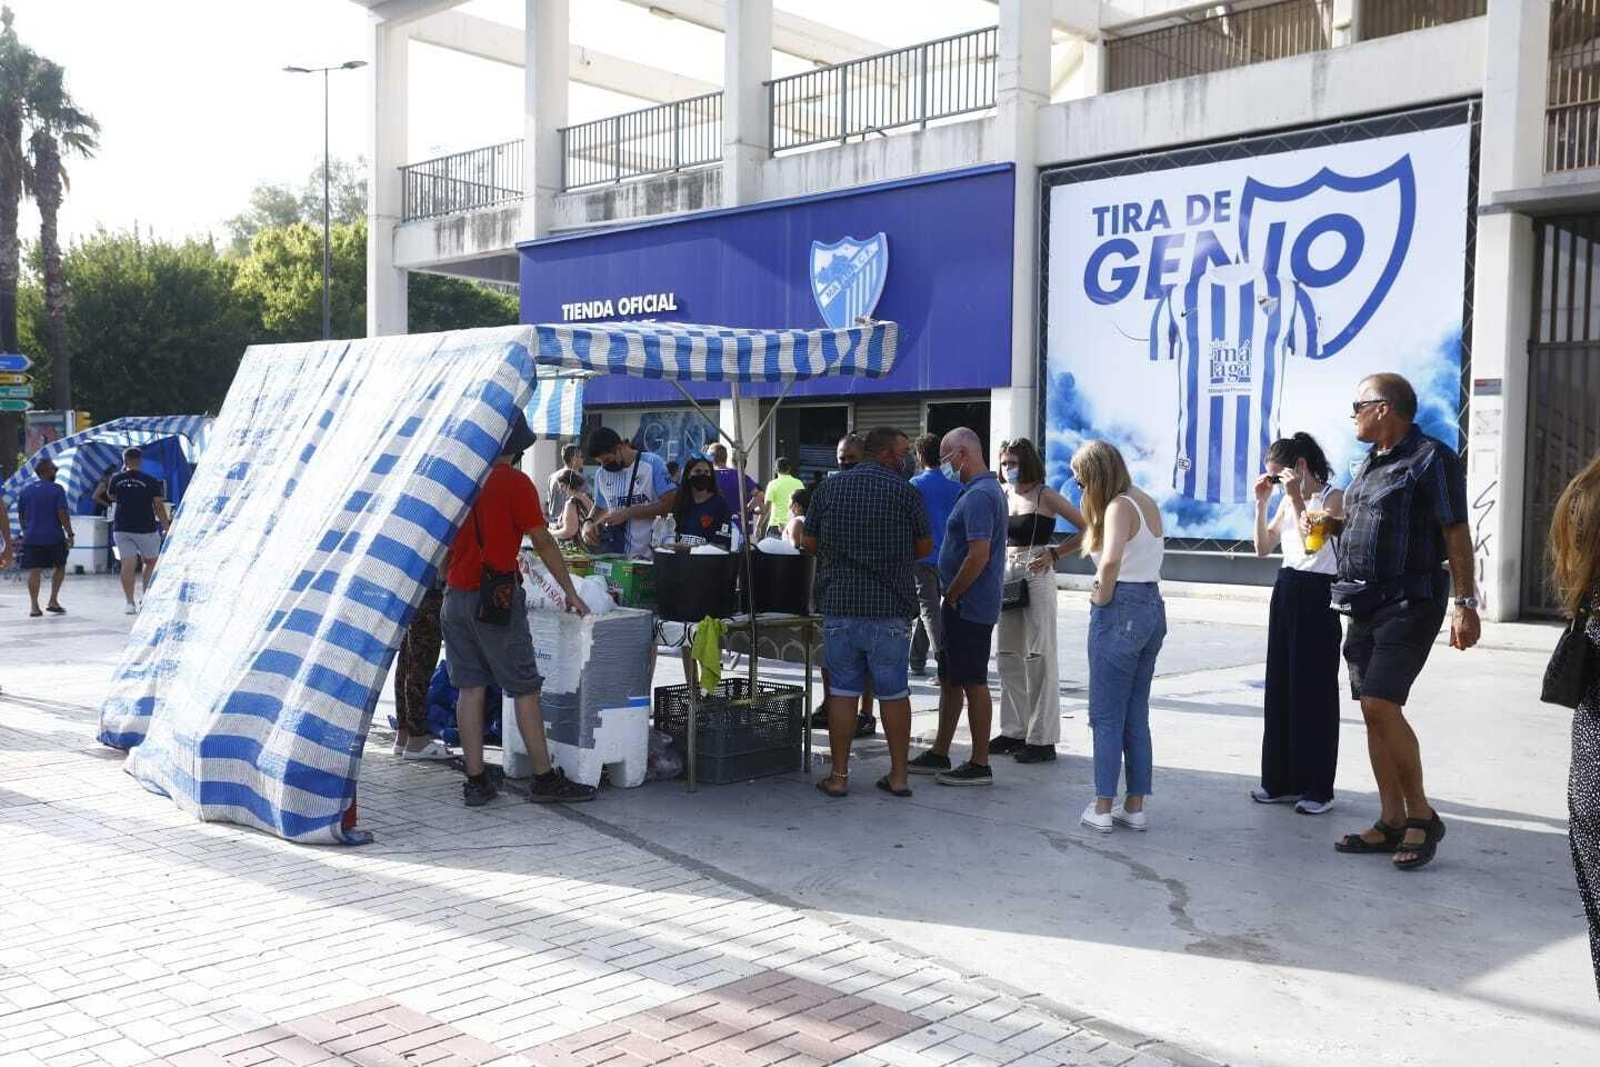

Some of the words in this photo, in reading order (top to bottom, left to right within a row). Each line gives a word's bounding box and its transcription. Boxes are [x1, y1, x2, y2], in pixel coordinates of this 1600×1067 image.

[1092, 199, 1171, 237] TIRA
[1186, 190, 1232, 227] DE
[561, 300, 614, 321] TIENDA
[618, 293, 677, 316] OFICIAL
